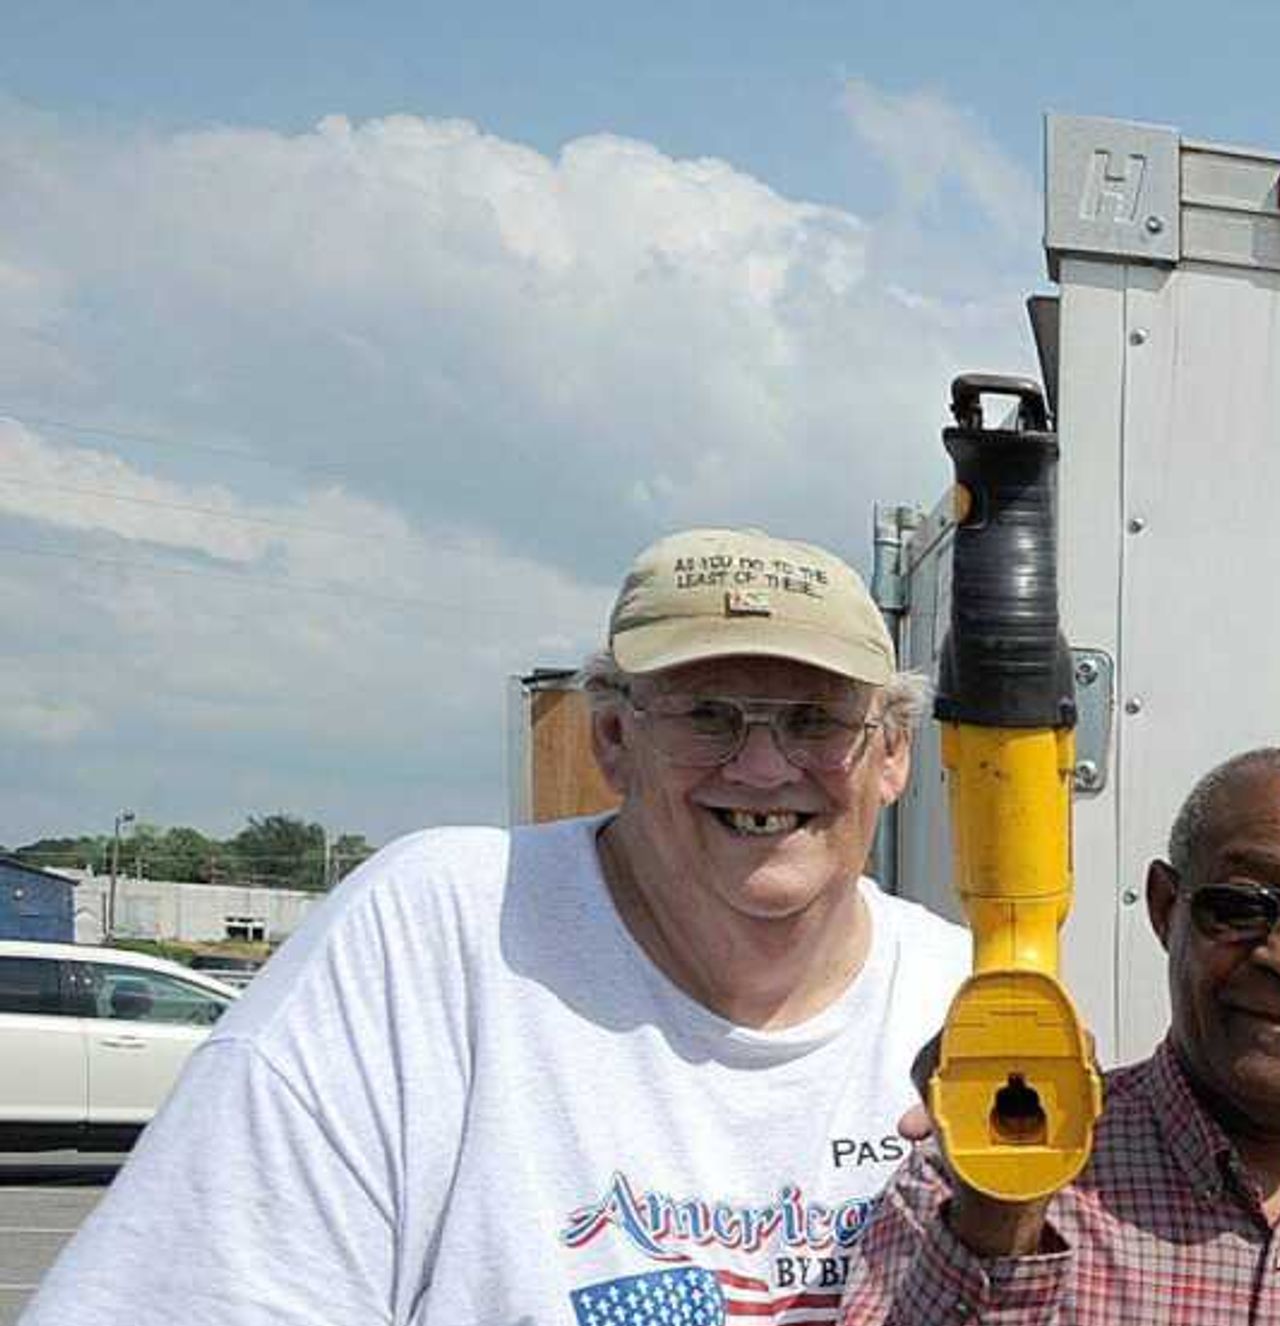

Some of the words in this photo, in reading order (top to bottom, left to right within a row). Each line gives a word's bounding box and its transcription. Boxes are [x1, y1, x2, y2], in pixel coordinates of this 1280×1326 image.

[674, 557, 695, 572] AS
[700, 554, 733, 569] YOU
[799, 566, 828, 585] THE
[676, 571, 728, 589] LEAST
[734, 571, 756, 584] OF
[832, 1136, 904, 1168] PAS
[776, 1256, 811, 1288] BY
